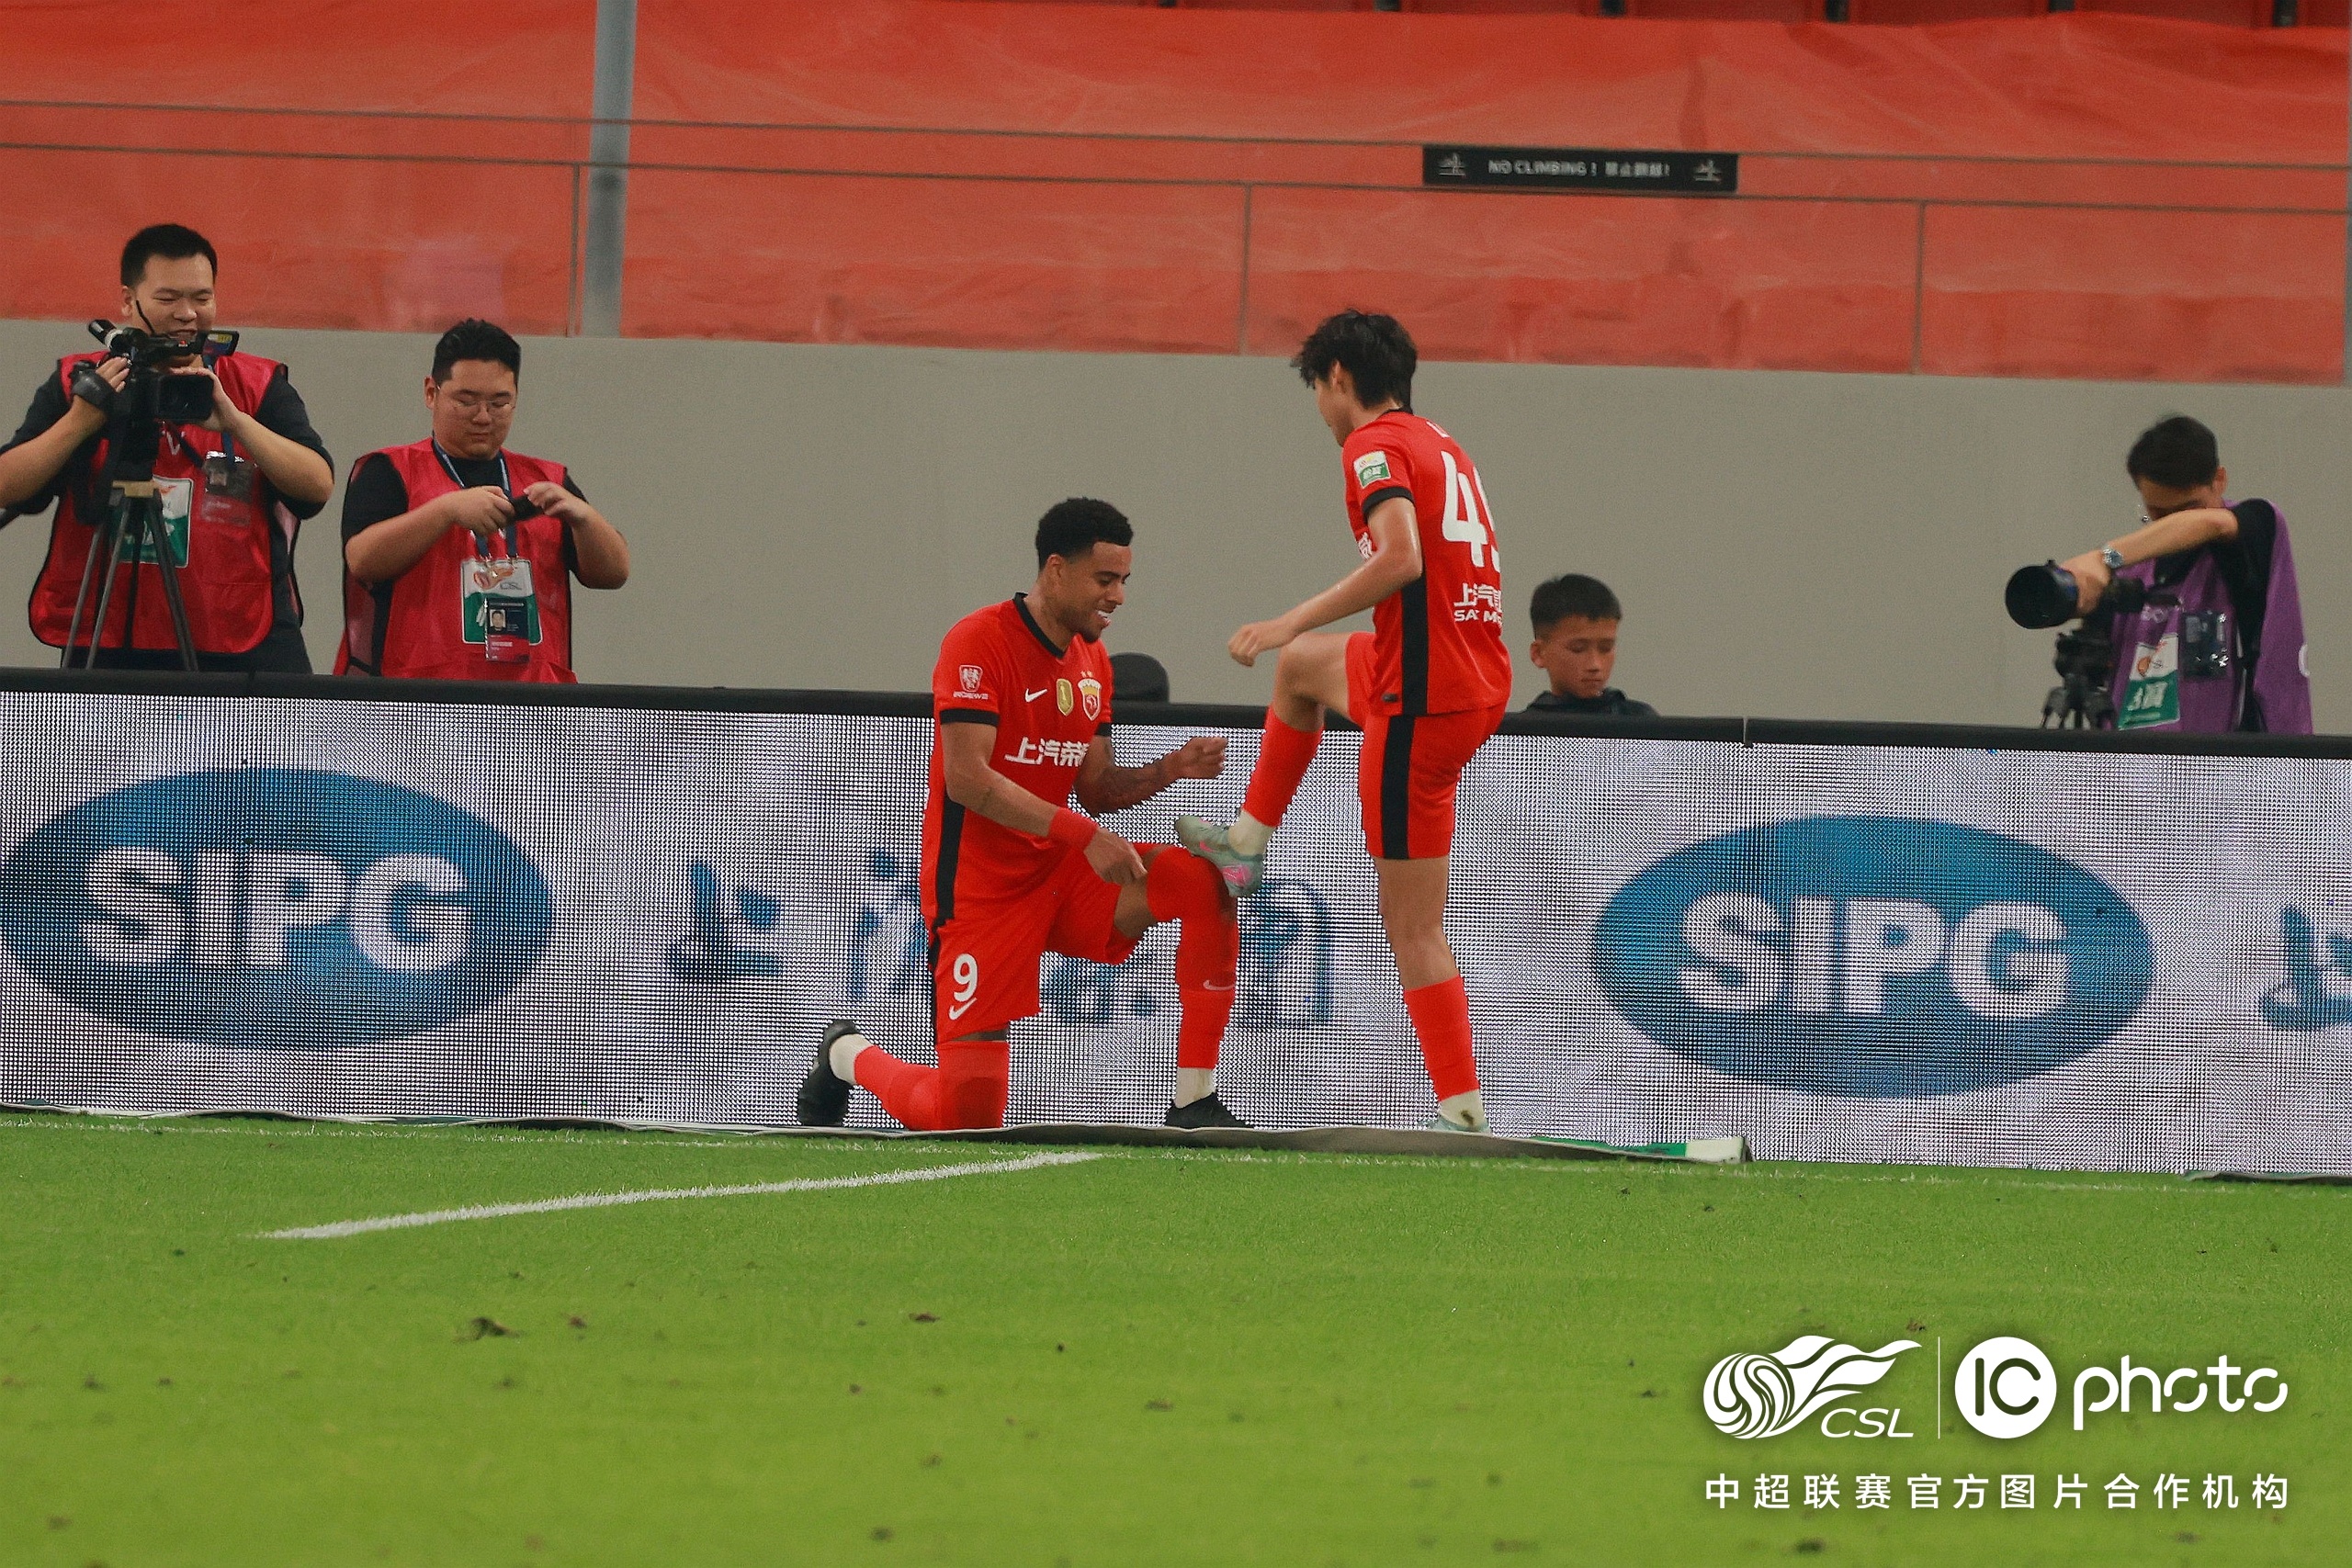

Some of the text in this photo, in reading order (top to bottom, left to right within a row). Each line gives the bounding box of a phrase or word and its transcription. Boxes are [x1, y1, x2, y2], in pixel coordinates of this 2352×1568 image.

[1487, 159, 1513, 175] NO
[1004, 736, 1091, 768] 上汽荣
[80, 844, 476, 976] SIPG
[953, 953, 978, 1002] 9
[1676, 890, 2072, 1022] SIPG
